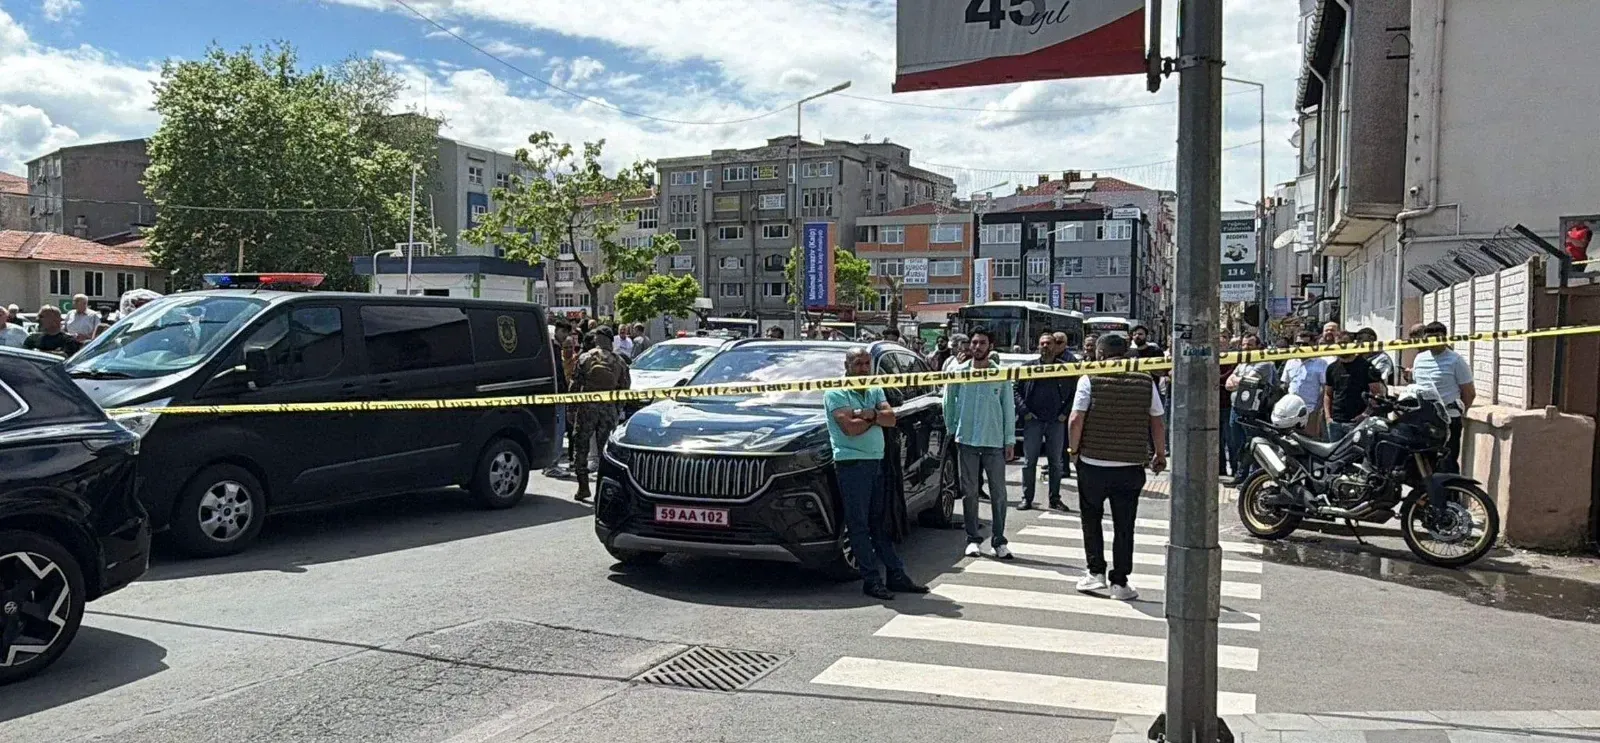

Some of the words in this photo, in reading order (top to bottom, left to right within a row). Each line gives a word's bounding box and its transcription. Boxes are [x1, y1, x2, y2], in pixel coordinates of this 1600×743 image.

[965, 0, 1045, 29] 45
[661, 508, 676, 520] 59
[678, 509, 698, 521] AA
[700, 511, 723, 523] 102
